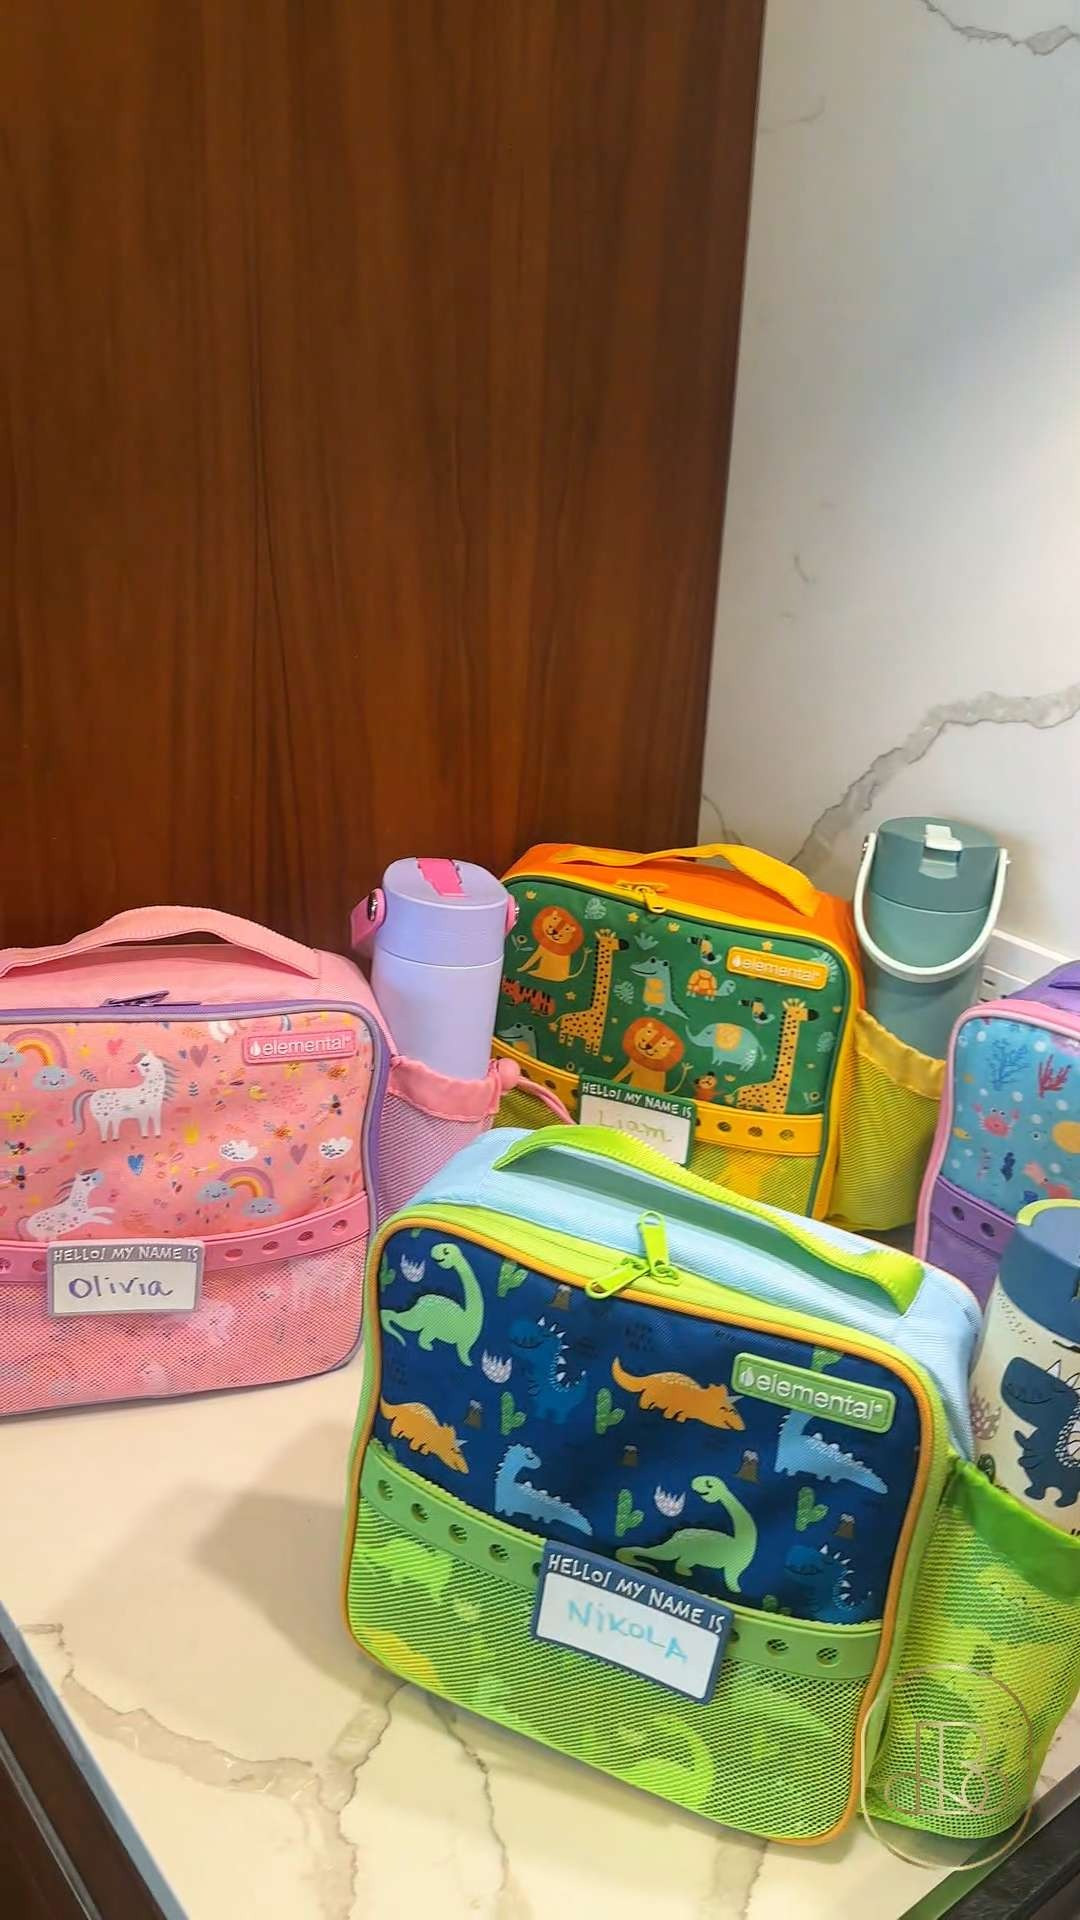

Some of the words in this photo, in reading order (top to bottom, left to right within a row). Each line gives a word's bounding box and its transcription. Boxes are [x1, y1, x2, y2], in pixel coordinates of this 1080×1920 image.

[743, 958, 819, 981] elemental
[262, 1036, 345, 1056] elemental
[582, 1082, 621, 1099] HELLO!
[625, 1092, 642, 1104] MY
[644, 1095, 679, 1114] NAME
[682, 1105, 693, 1118] IS
[53, 1248, 105, 1261] HELLO!
[111, 1247, 134, 1259] MY
[139, 1246, 183, 1259] NAME
[187, 1247, 199, 1261] IS
[68, 1275, 174, 1298] Olivia
[756, 1372, 876, 1421] elemental
[548, 1554, 612, 1581] HELLO!
[616, 1578, 646, 1599] MY
[649, 1590, 705, 1624] NAME
[708, 1614, 726, 1634] IS
